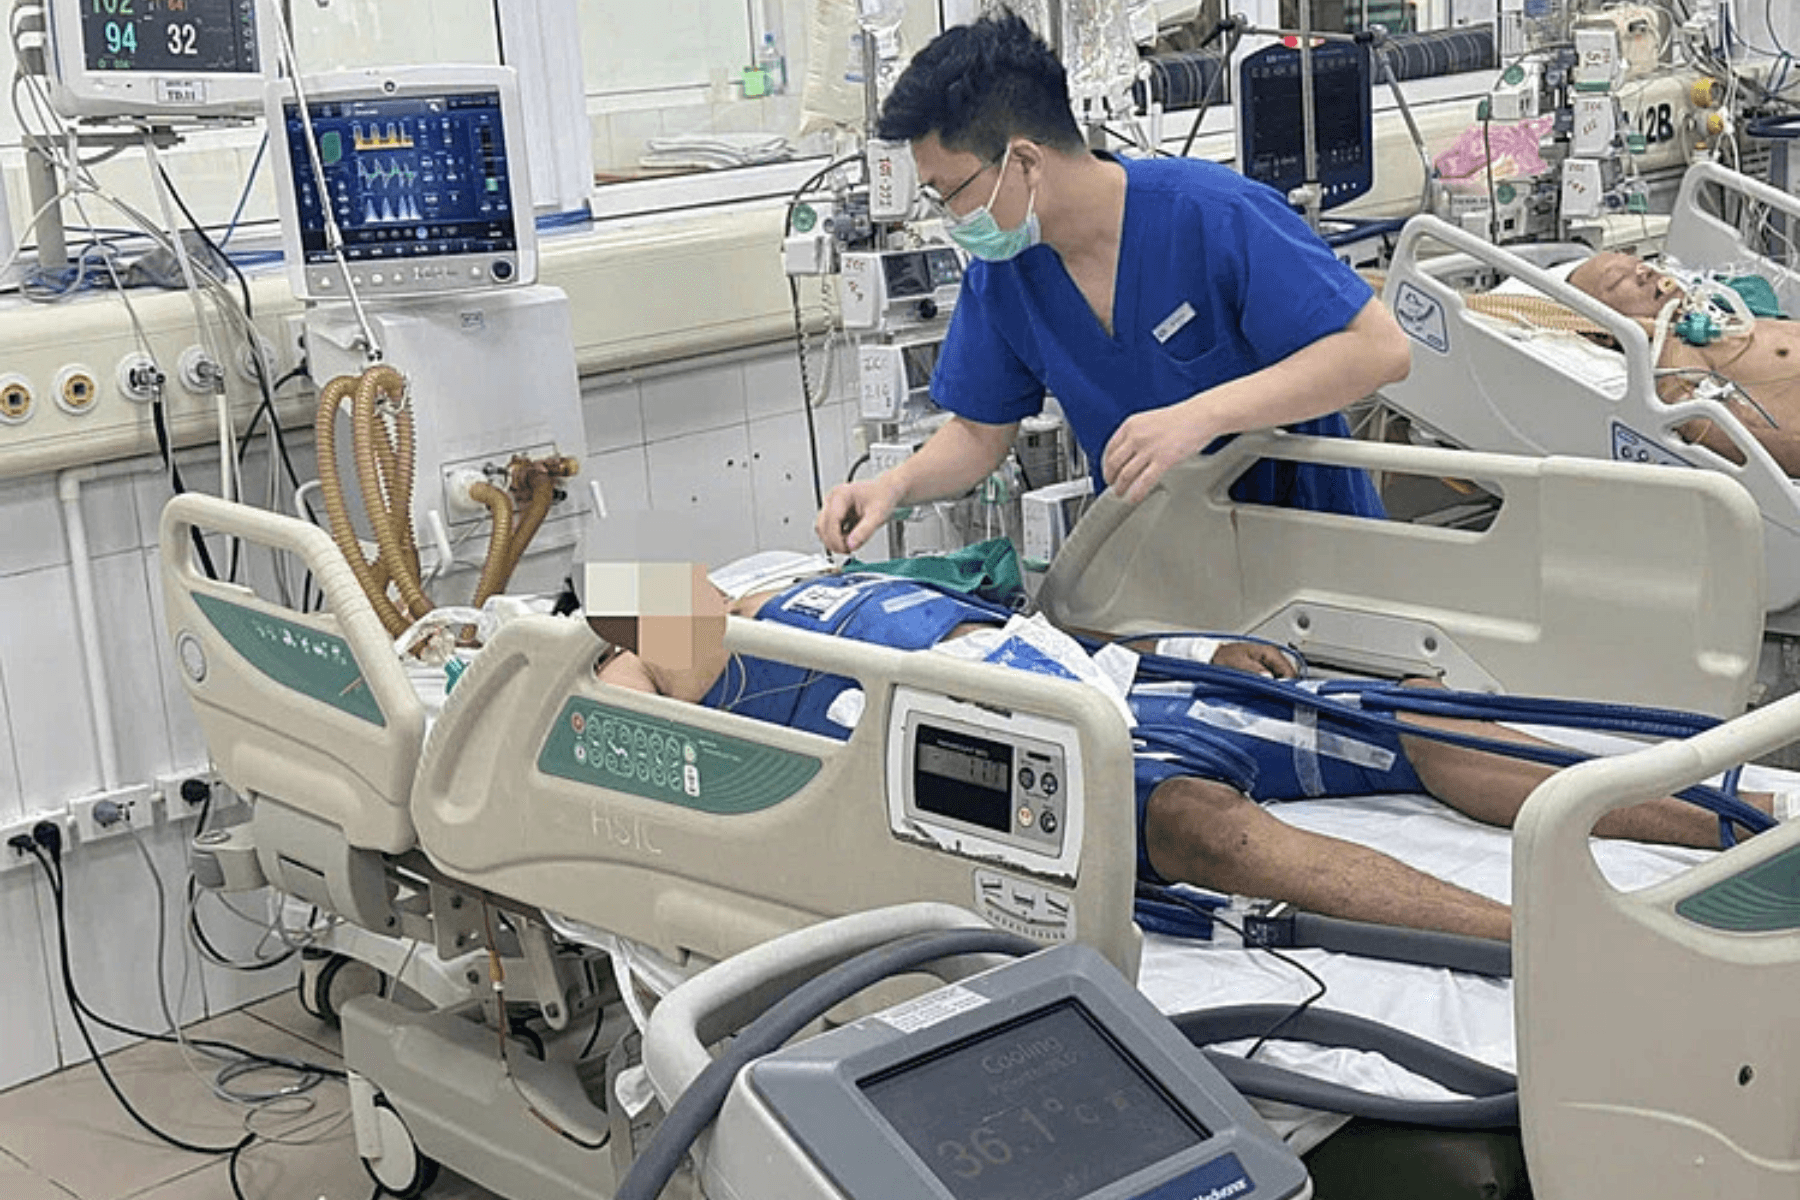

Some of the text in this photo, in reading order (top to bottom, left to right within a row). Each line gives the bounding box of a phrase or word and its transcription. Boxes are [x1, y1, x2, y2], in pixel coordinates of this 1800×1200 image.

[105, 21, 138, 54] 94
[167, 23, 198, 54] 32
[981, 1034, 1065, 1075] Cooling
